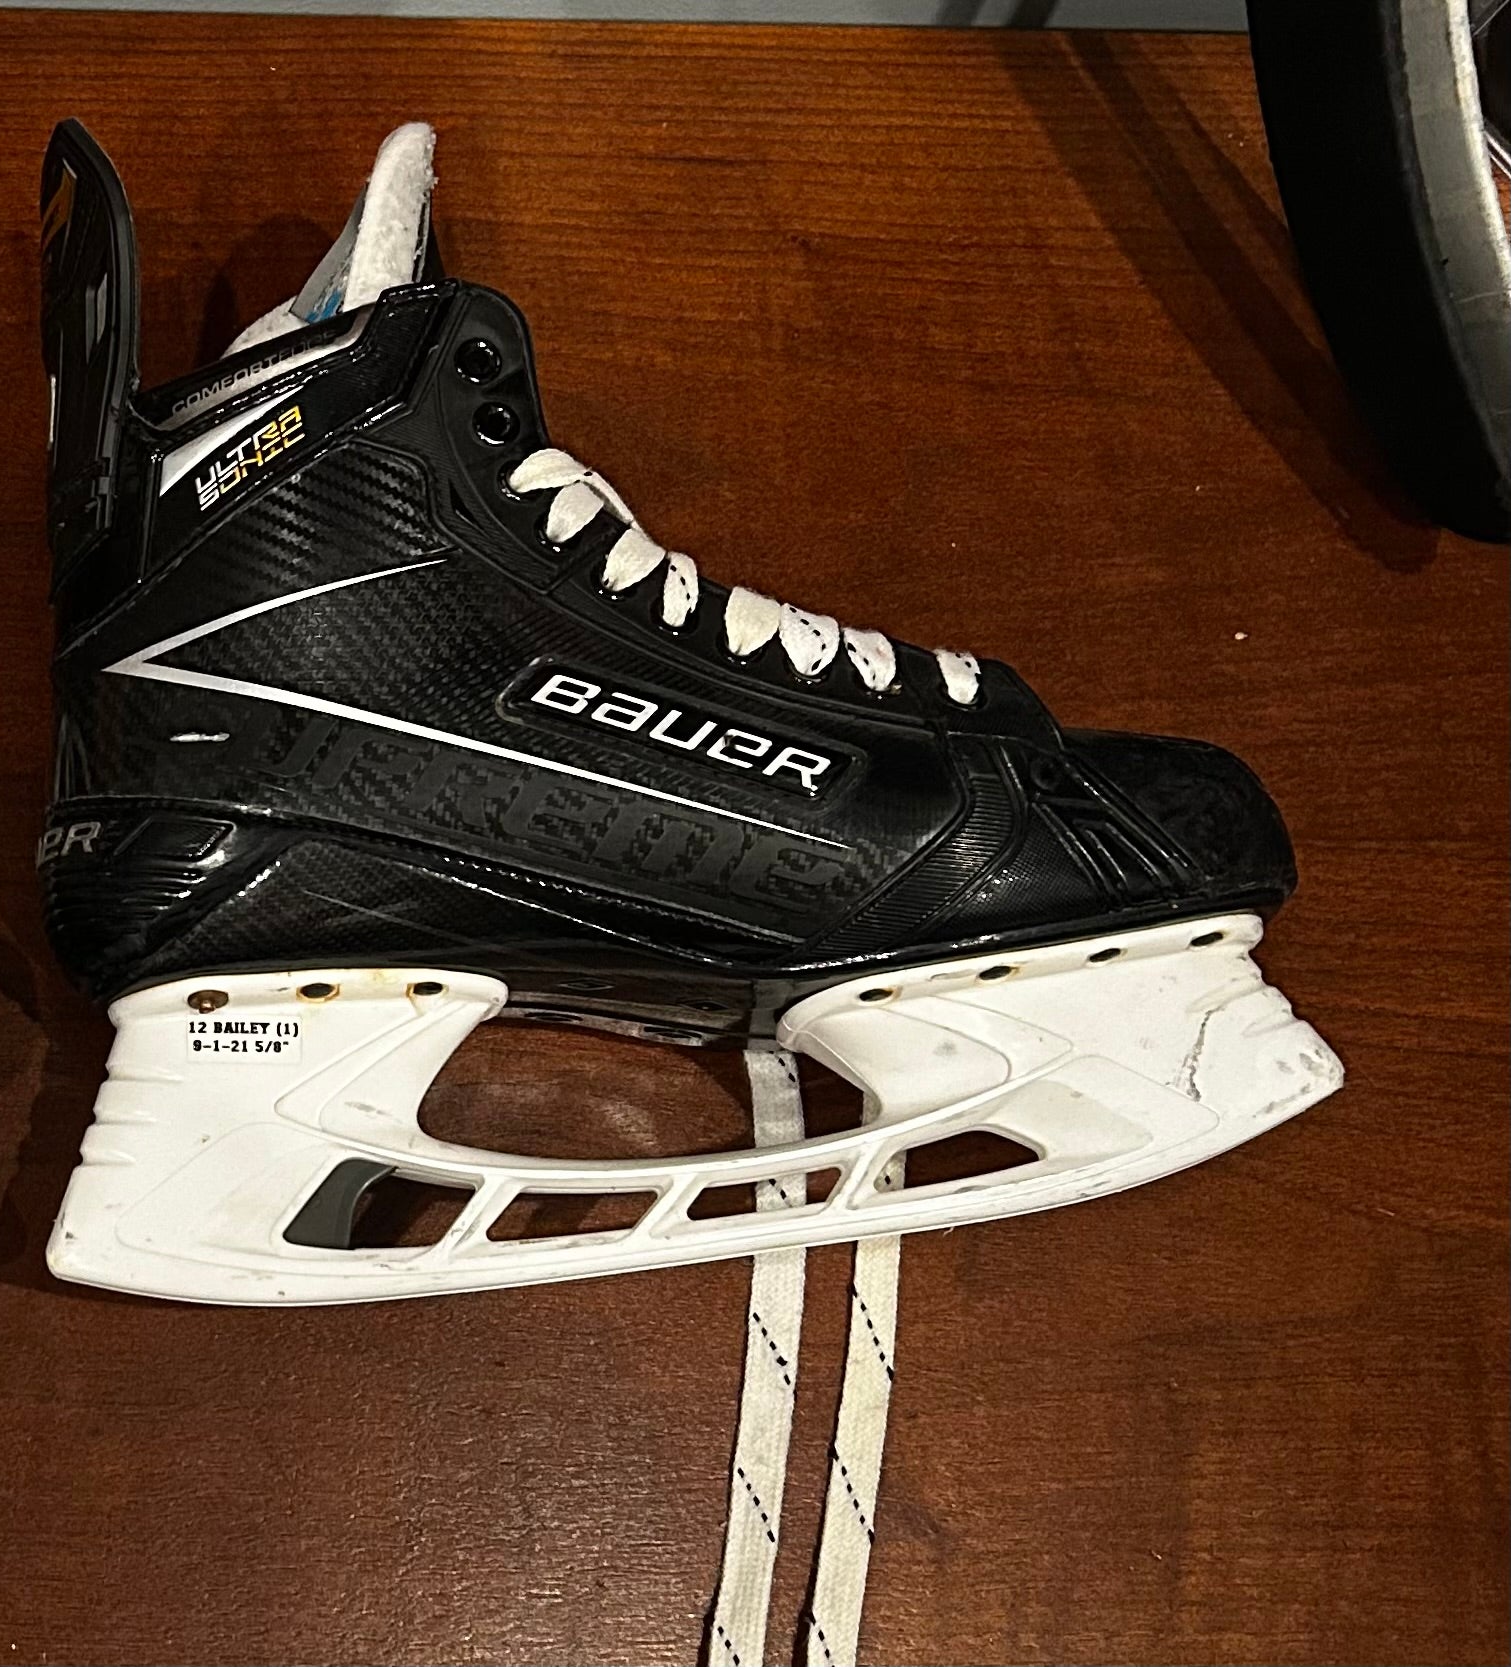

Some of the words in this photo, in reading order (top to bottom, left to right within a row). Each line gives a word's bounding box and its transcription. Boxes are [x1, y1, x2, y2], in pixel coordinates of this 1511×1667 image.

[195, 405, 302, 494] ULTRA
[198, 422, 305, 511] SONIC
[530, 674, 832, 793] BAUER
[189, 1021, 207, 1034] 12
[213, 1022, 270, 1034] BAILEY
[276, 1022, 299, 1037] (1)
[193, 1040, 248, 1052] 9-1-21
[255, 1041, 289, 1053] 5/8"
